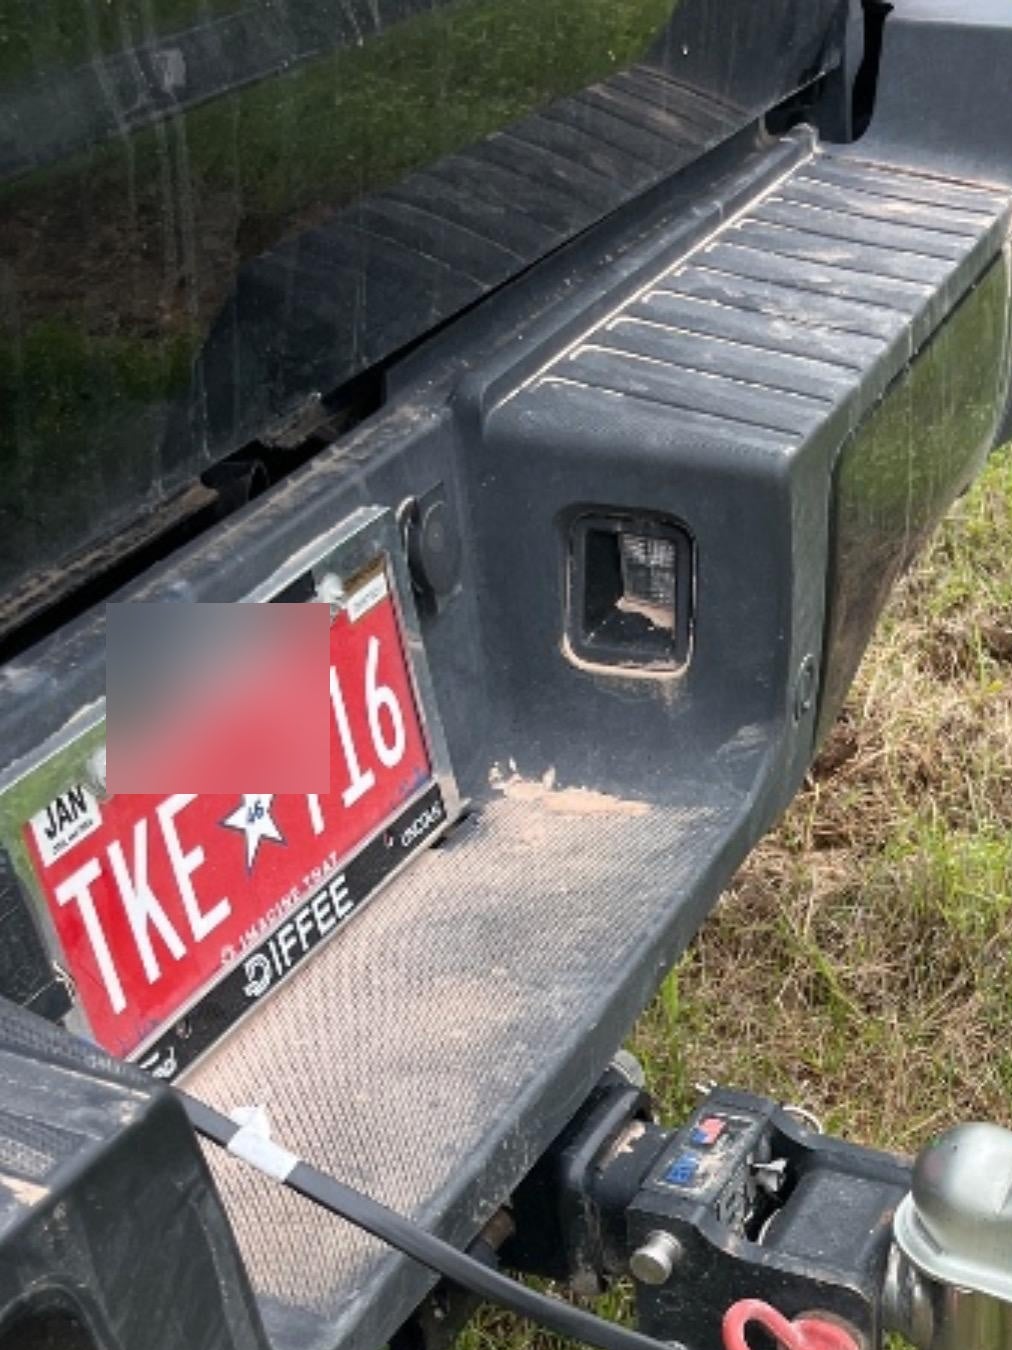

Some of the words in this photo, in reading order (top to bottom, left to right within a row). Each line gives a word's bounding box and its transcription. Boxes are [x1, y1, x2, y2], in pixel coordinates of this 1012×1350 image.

[44, 784, 87, 840] JAN
[55, 794, 231, 1015] TKE
[243, 873, 355, 997] DIFFEE
